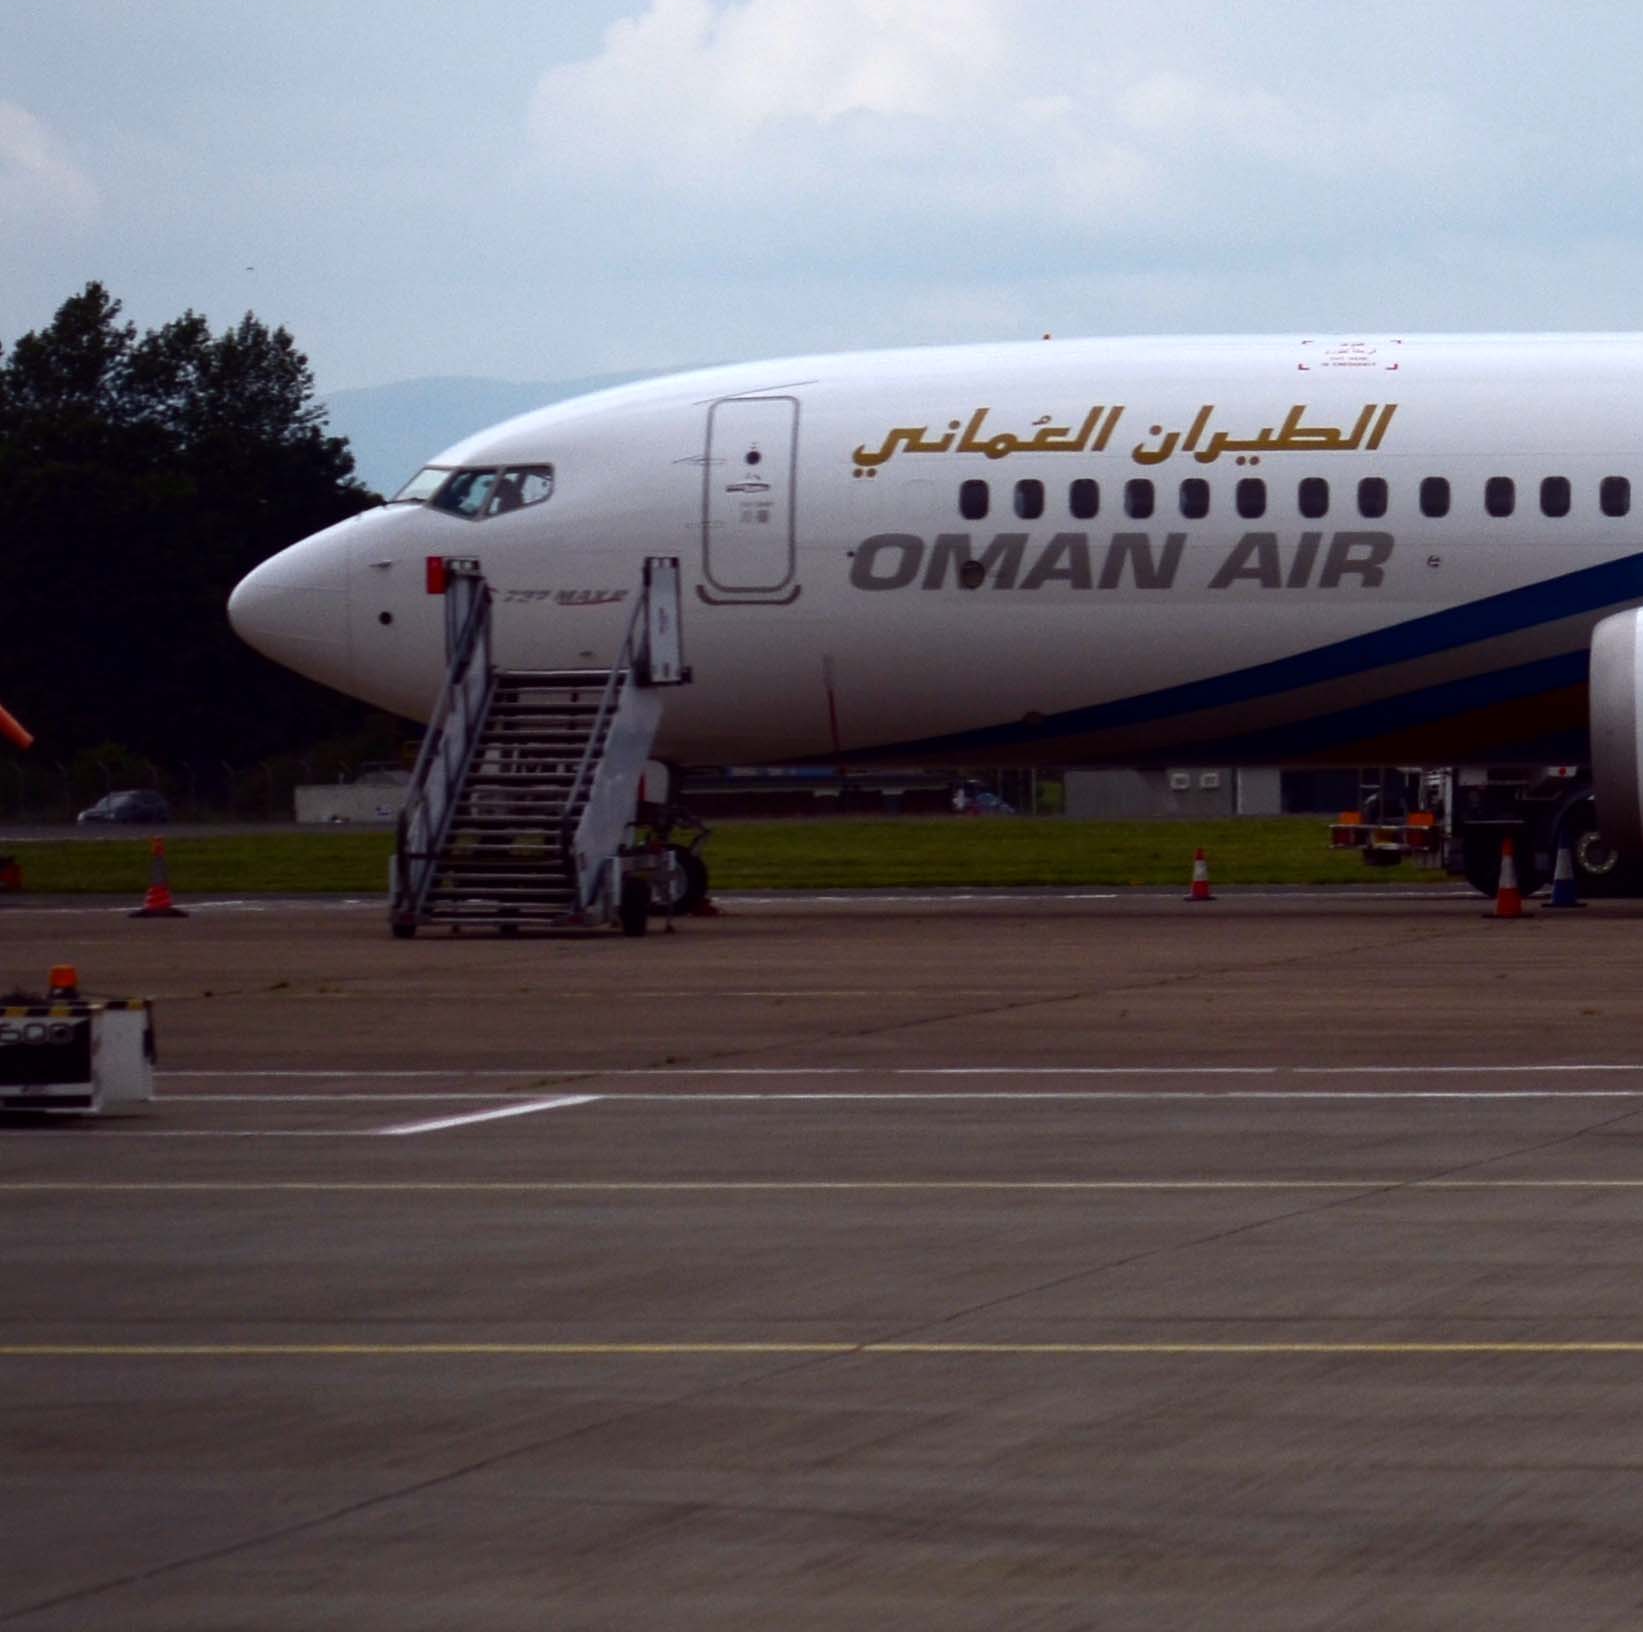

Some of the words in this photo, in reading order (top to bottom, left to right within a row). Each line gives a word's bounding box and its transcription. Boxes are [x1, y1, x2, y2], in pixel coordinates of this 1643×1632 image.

[1132, 404, 1397, 466] الطيران
[849, 532, 1188, 591] OMAN
[1207, 531, 1395, 590] AIR
